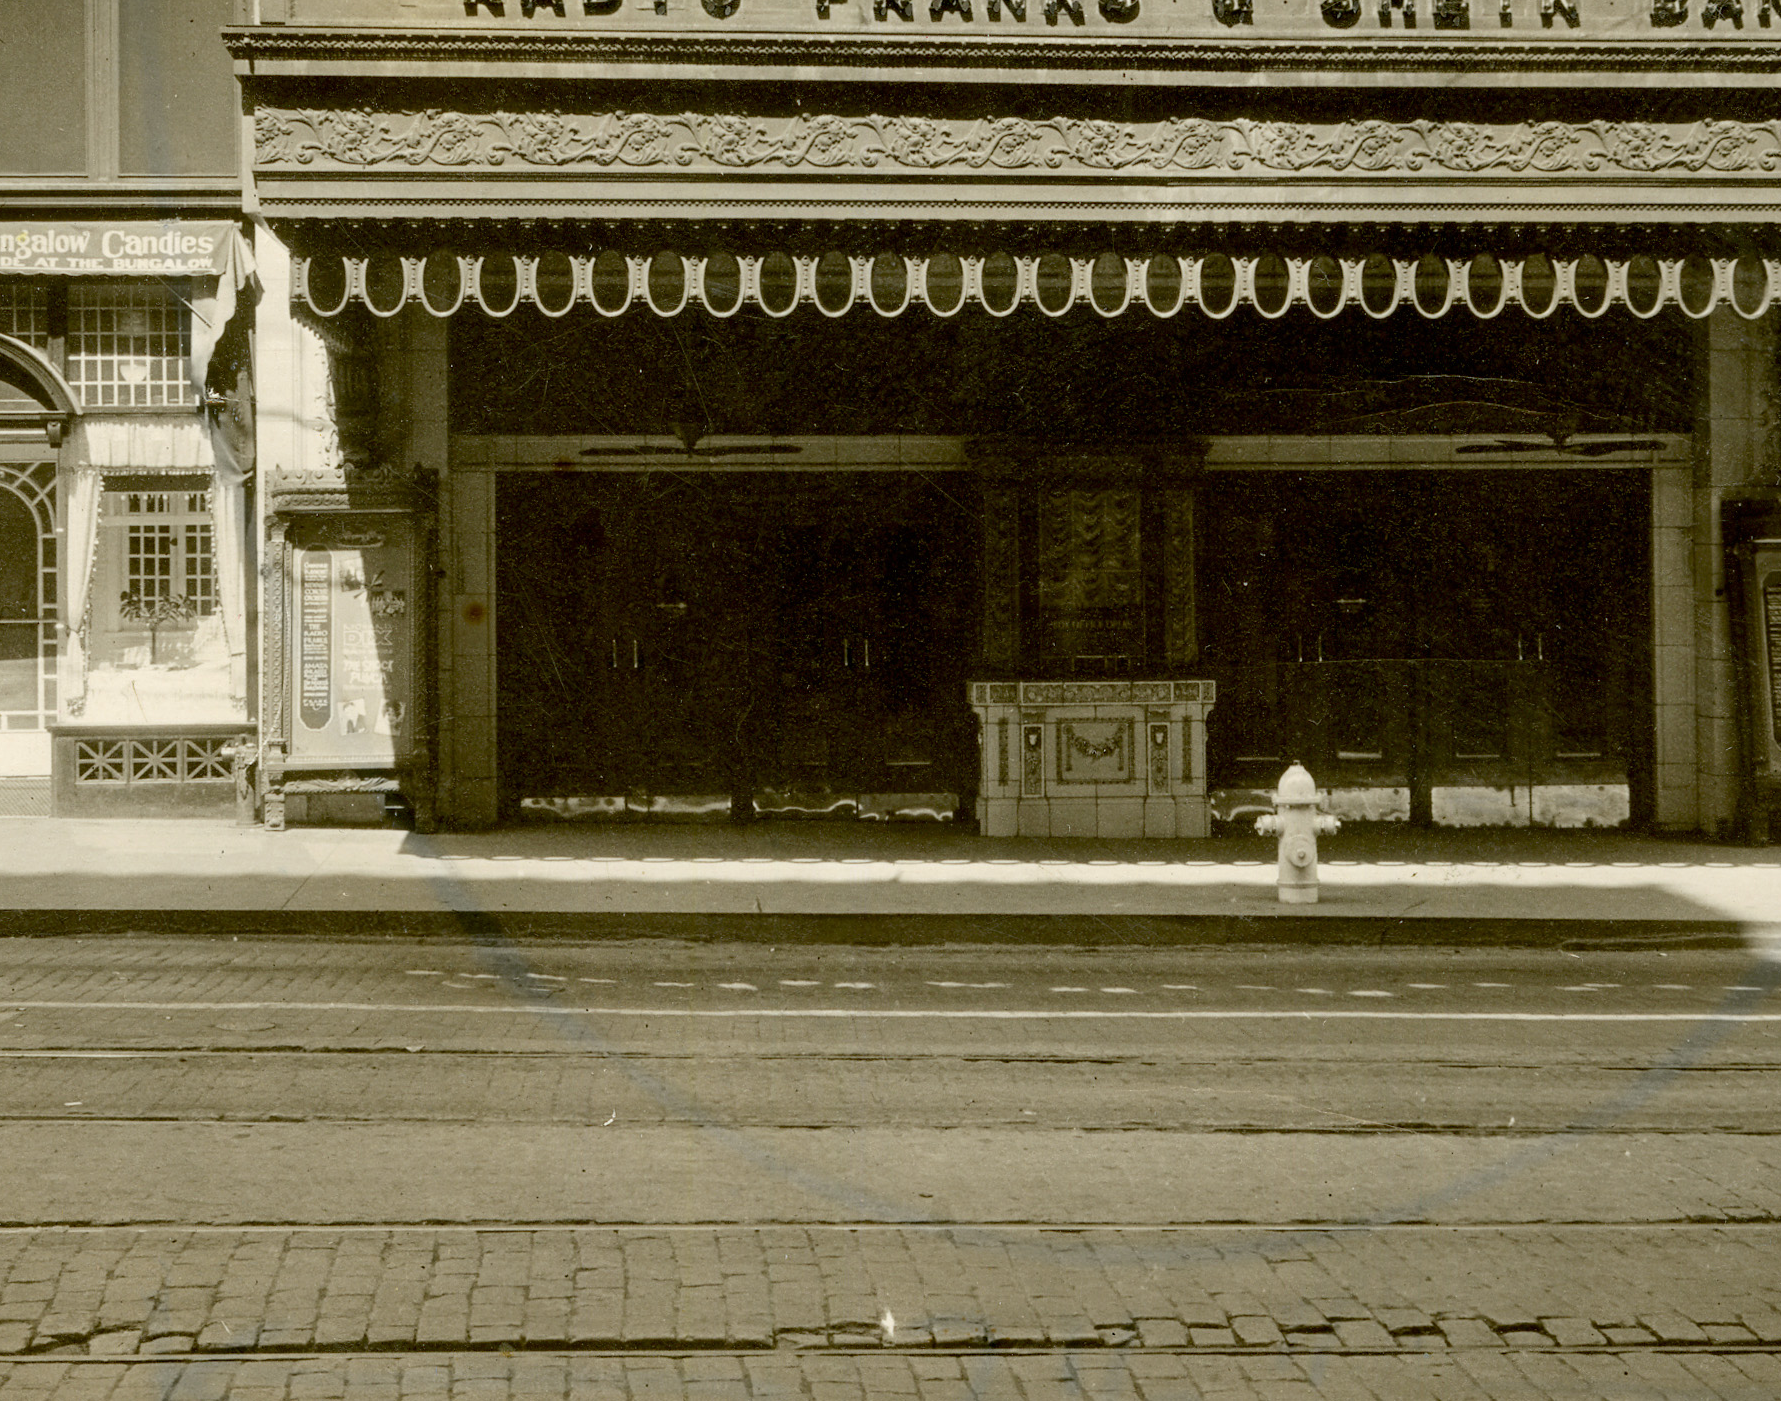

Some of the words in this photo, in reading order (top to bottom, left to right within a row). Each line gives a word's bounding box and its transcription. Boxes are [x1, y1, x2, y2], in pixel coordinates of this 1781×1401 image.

[102, 230, 215, 259] Candies
[34, 256, 60, 268] AT
[68, 257, 104, 269] THE
[112, 257, 214, 269] BUNGALOW
[343, 630, 393, 646] DIX
